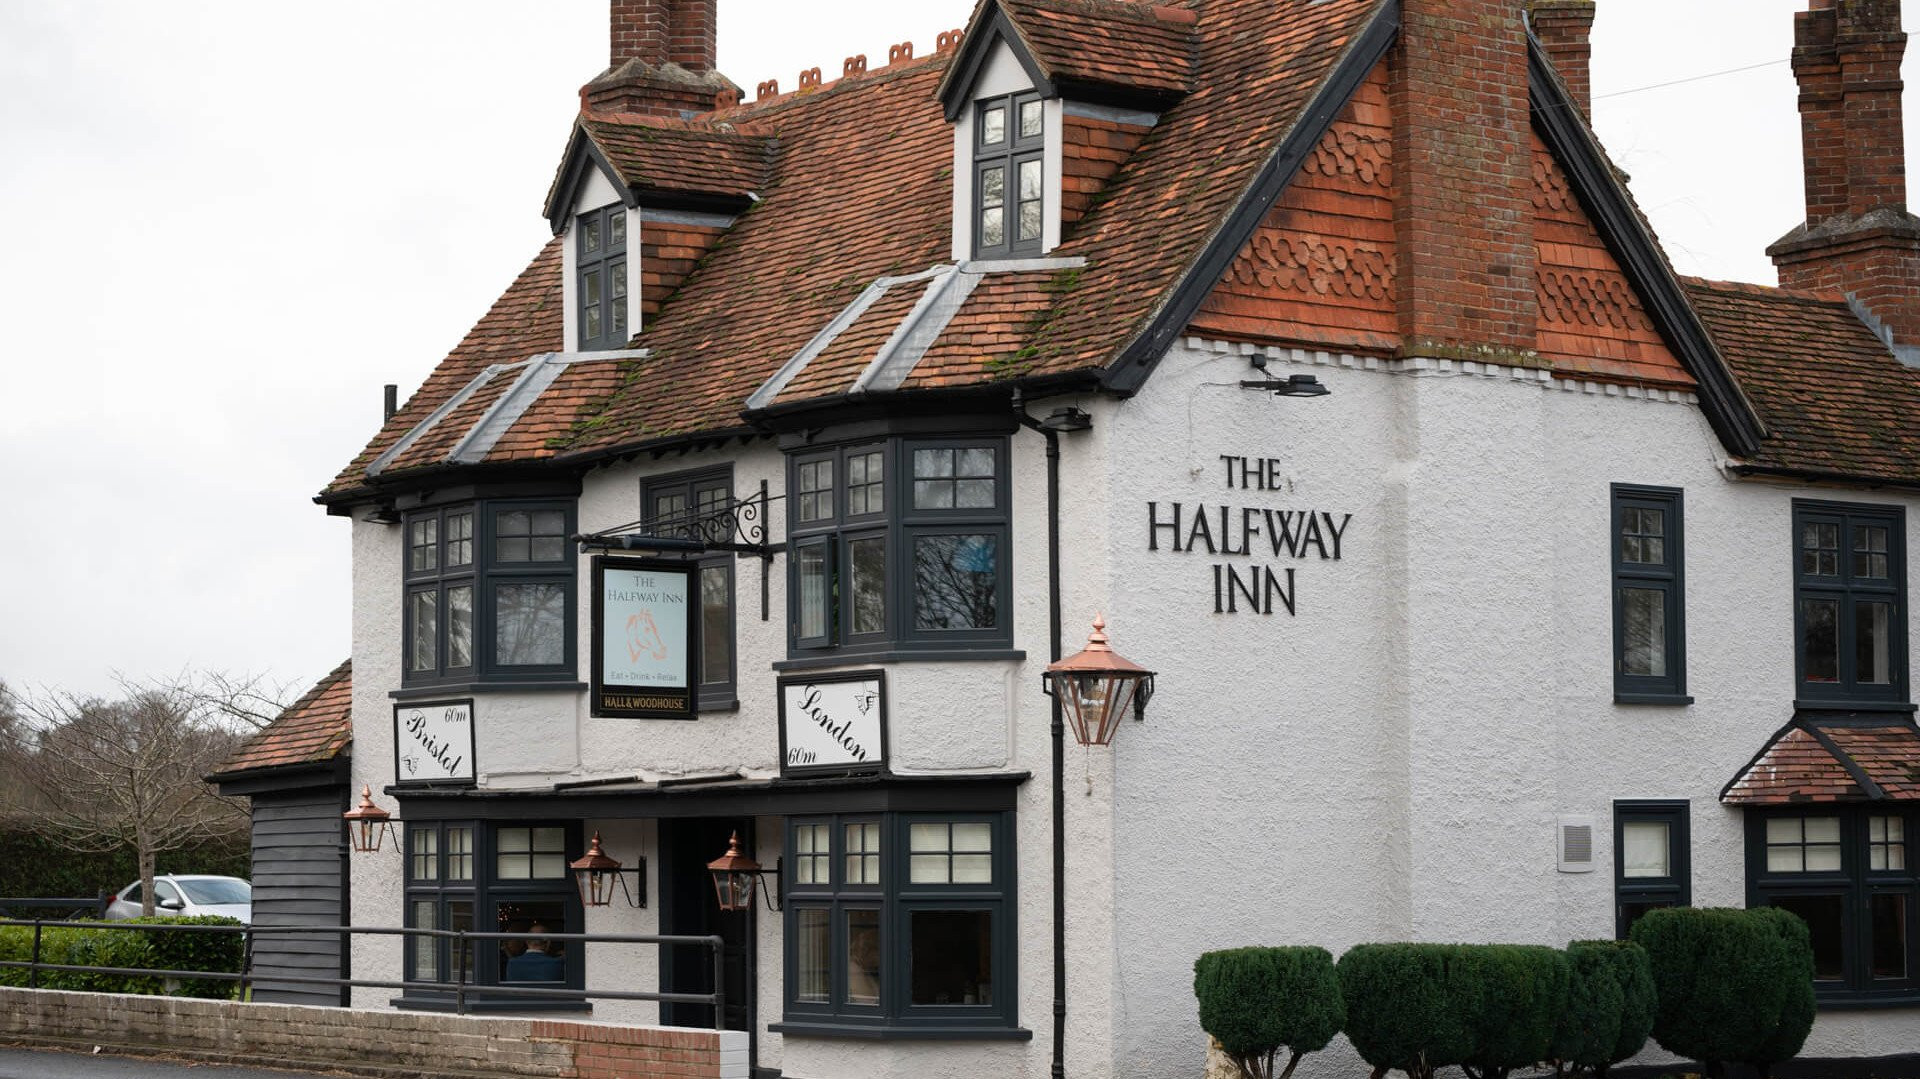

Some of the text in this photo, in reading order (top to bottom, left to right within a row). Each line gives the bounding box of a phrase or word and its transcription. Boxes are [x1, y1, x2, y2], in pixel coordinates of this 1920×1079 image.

[1219, 454, 1282, 491] THE
[1147, 501, 1353, 560] HALFWAY
[632, 575, 656, 588] THE
[1213, 563, 1296, 617] INN
[608, 589, 684, 604] HALFWAY INN
[610, 671, 624, 680] Eat
[630, 672, 651, 681] Drink
[445, 707, 466, 723] 60m
[798, 683, 866, 762] London
[406, 709, 462, 776] Bristol
[788, 747, 816, 764] 60m
